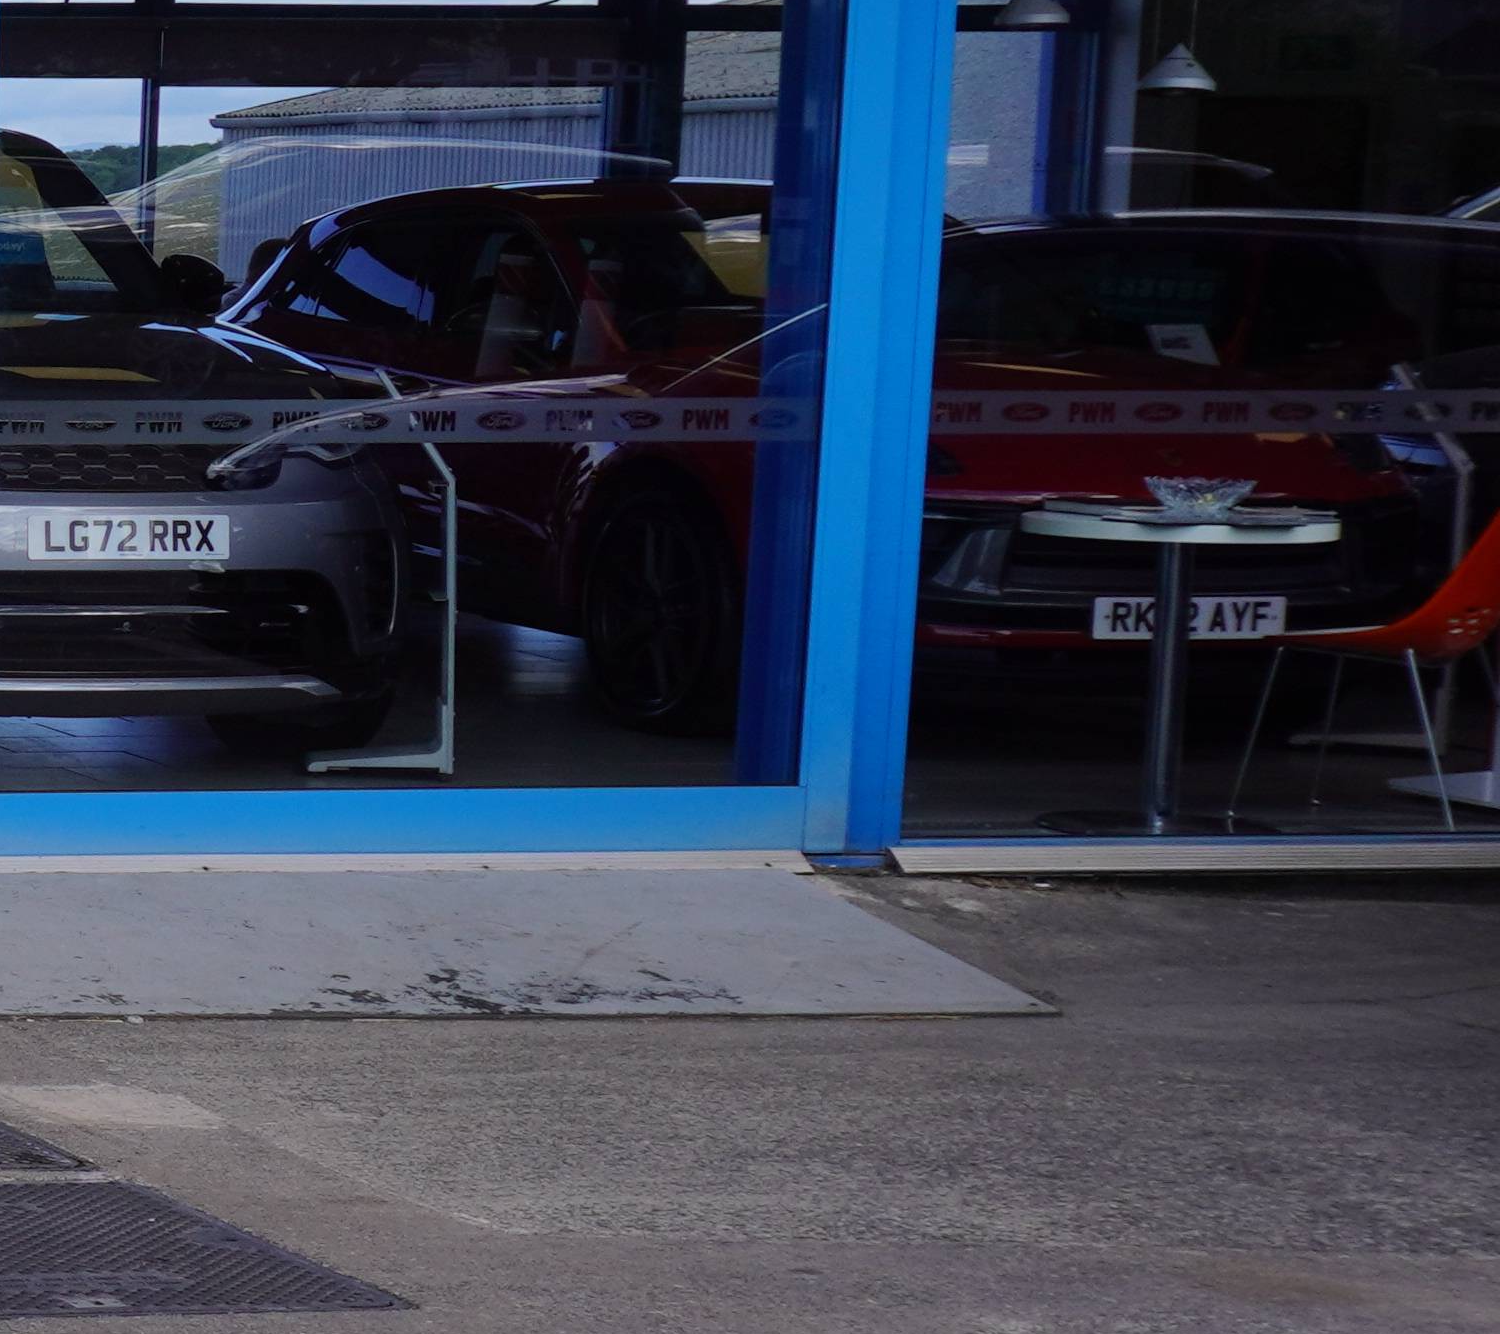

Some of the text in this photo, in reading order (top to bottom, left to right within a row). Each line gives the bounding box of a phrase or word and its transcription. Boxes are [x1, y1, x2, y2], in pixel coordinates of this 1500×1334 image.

[681, 409, 731, 431] PWM
[1067, 401, 1117, 423] PWM
[1202, 401, 1250, 423] PWM
[44, 519, 215, 552] LG72 RRX
[1111, 601, 1271, 633] RK2 AYF
